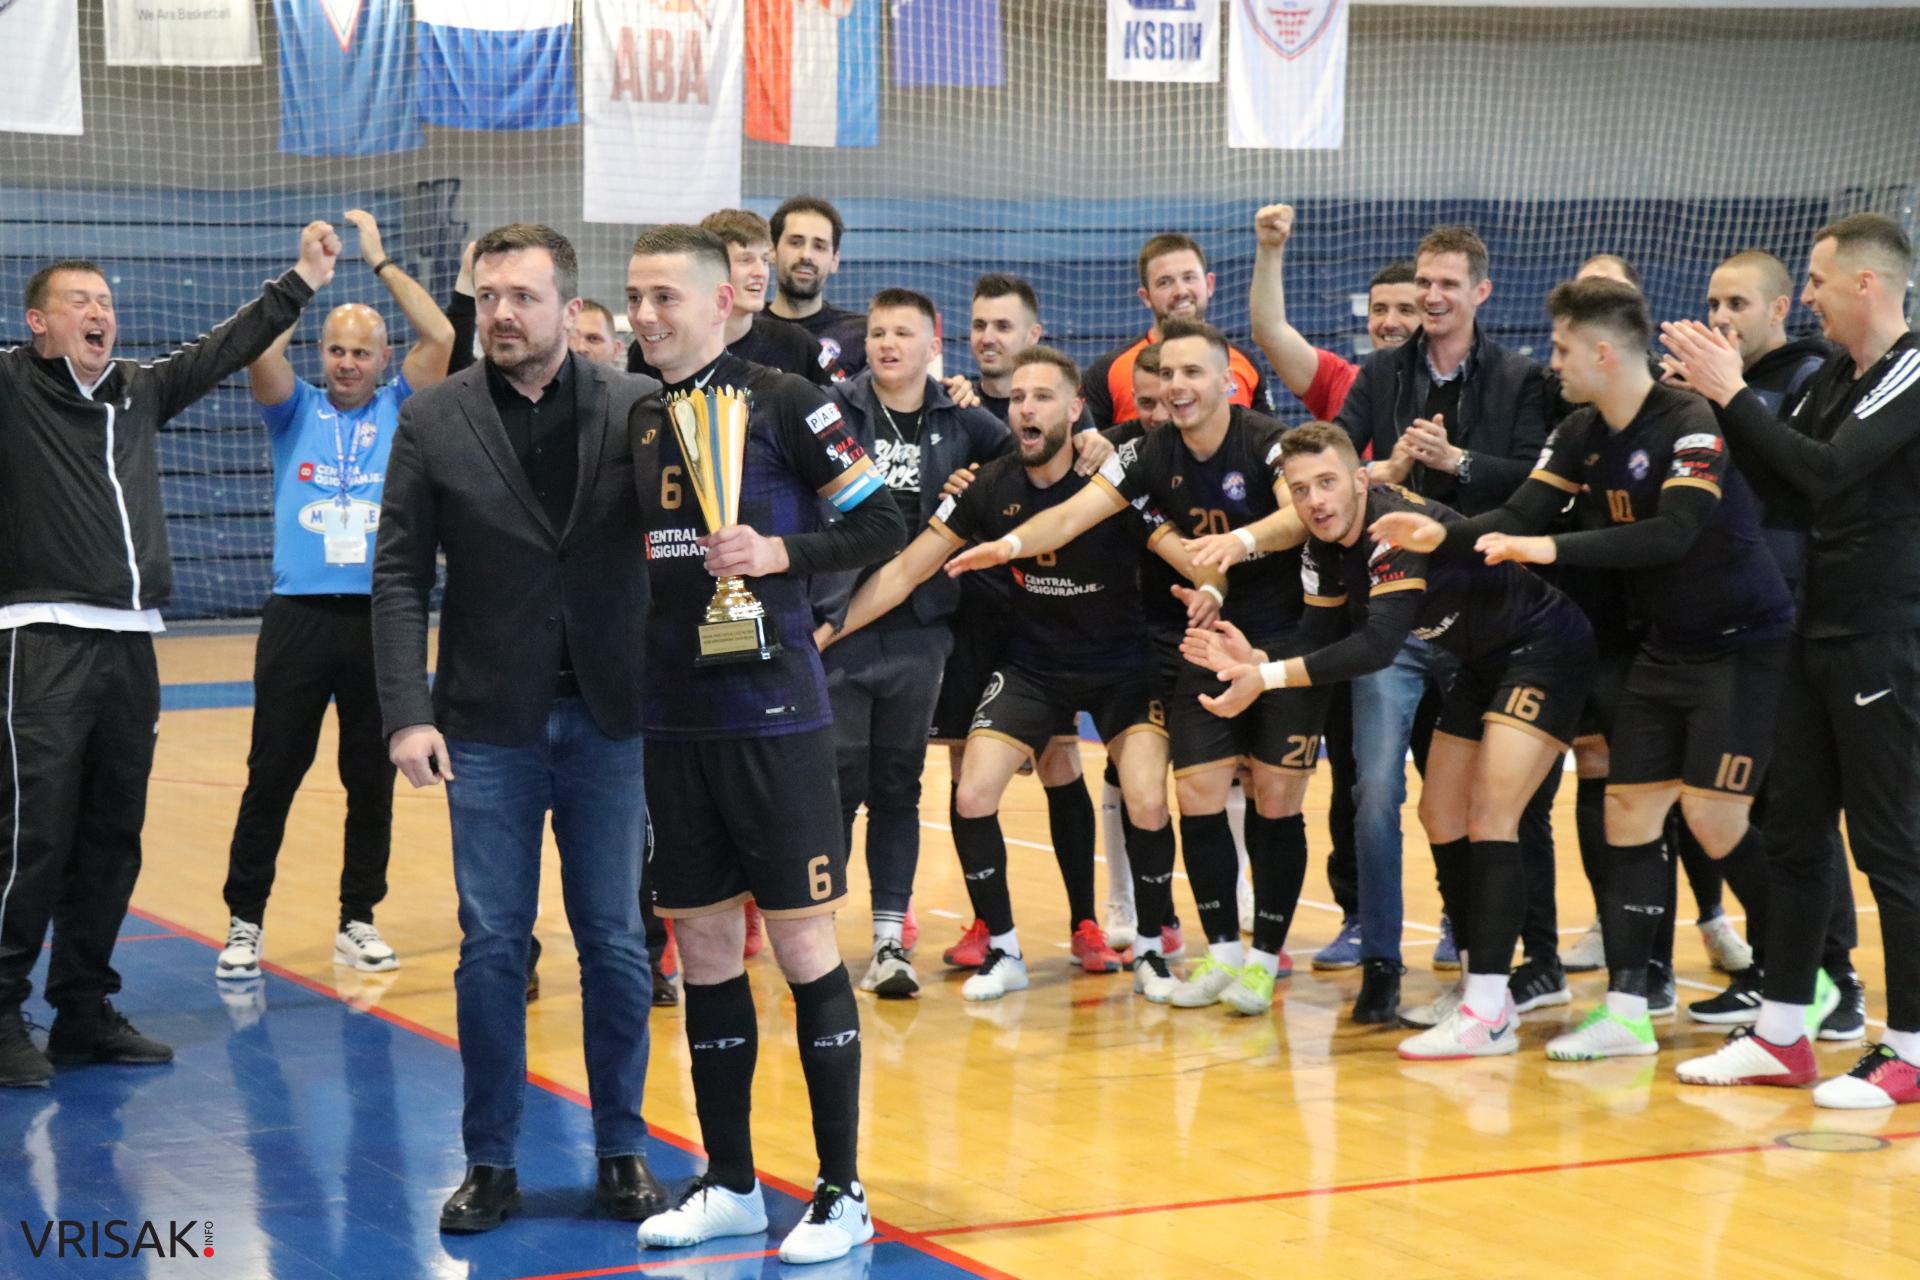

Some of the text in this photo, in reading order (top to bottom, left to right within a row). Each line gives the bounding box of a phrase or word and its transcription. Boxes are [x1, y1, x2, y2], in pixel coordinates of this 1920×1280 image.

[136, 9, 154, 20] We
[157, 8, 176, 20] Are
[1124, 21, 1202, 61] KSBIH
[610, 27, 709, 104] ABA
[661, 465, 682, 509] 6
[1188, 507, 1230, 536] 20
[1606, 489, 1635, 522] 10
[649, 527, 699, 544] CENTRAL
[1025, 574, 1075, 587] CENTRAL
[1025, 584, 1097, 597] OSIGURANJE
[1149, 700, 1165, 726] 8
[1504, 686, 1545, 721] 16
[1281, 735, 1319, 767] 20
[1714, 753, 1753, 791] 10
[808, 855, 832, 900] 6
